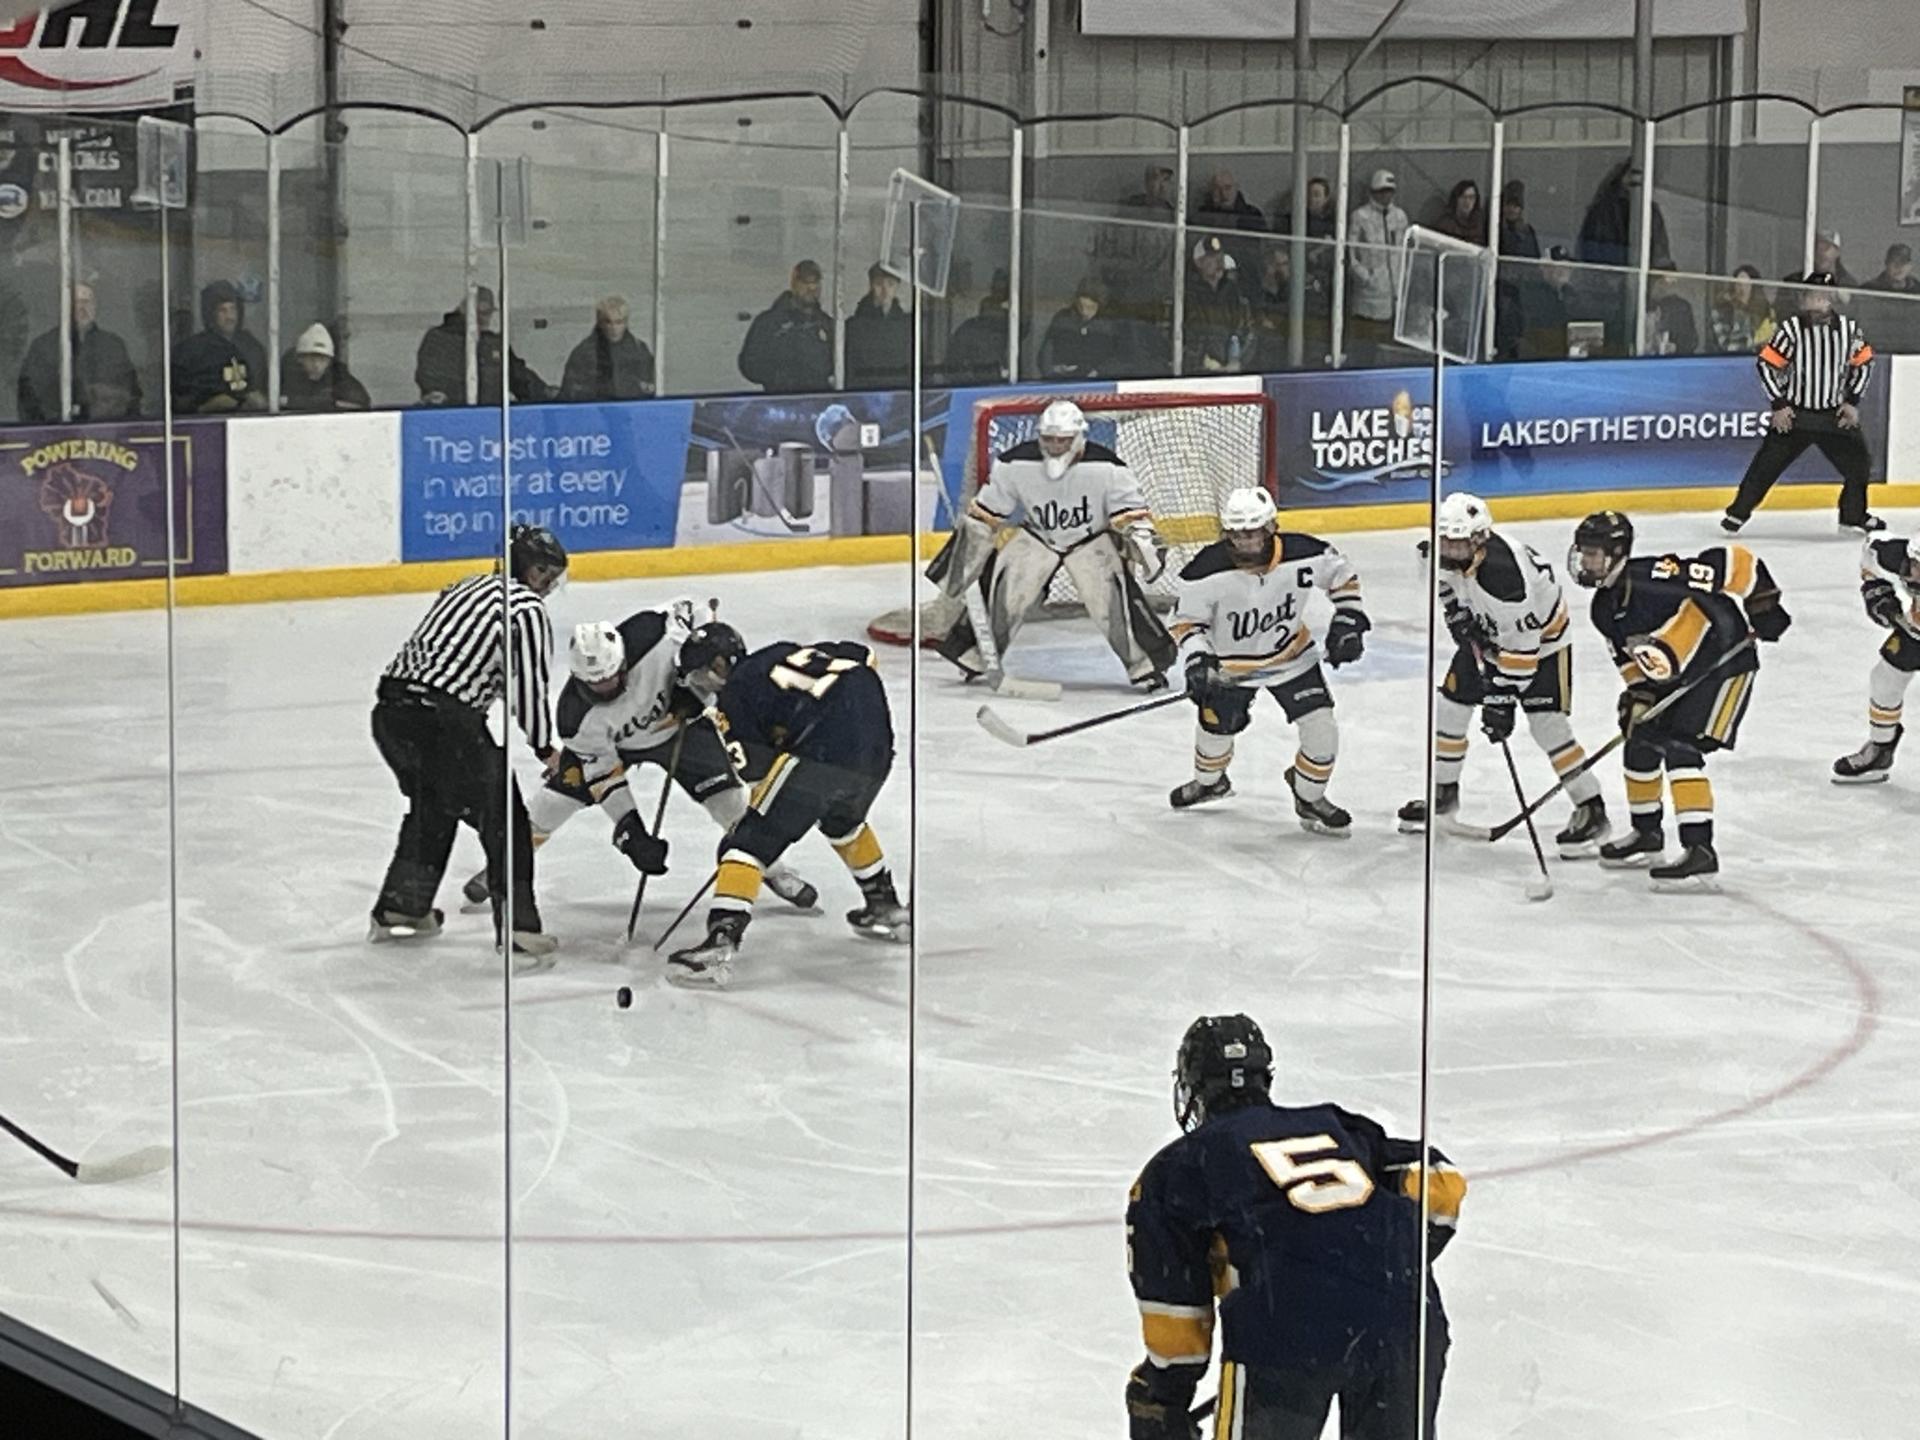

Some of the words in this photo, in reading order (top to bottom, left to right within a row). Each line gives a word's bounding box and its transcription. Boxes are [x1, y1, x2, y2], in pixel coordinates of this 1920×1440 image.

[1312, 408, 1391, 441] LAKE
[20, 439, 139, 477] POWERING
[423, 435, 474, 463] The
[542, 433, 612, 458] name
[424, 474, 446, 499] in
[528, 470, 554, 495] at
[559, 467, 629, 497] every
[424, 510, 467, 541] tap
[472, 508, 495, 533] in
[499, 506, 555, 531] our
[559, 502, 630, 528] home
[1031, 495, 1093, 530] West
[24, 547, 137, 573] FORWARD
[1297, 566, 1313, 588] C
[1687, 562, 1715, 593] 19
[1226, 592, 1297, 641] West
[1273, 624, 1291, 651] 2
[1231, 1068, 1245, 1088] 5
[1250, 1134, 1375, 1214] 5
